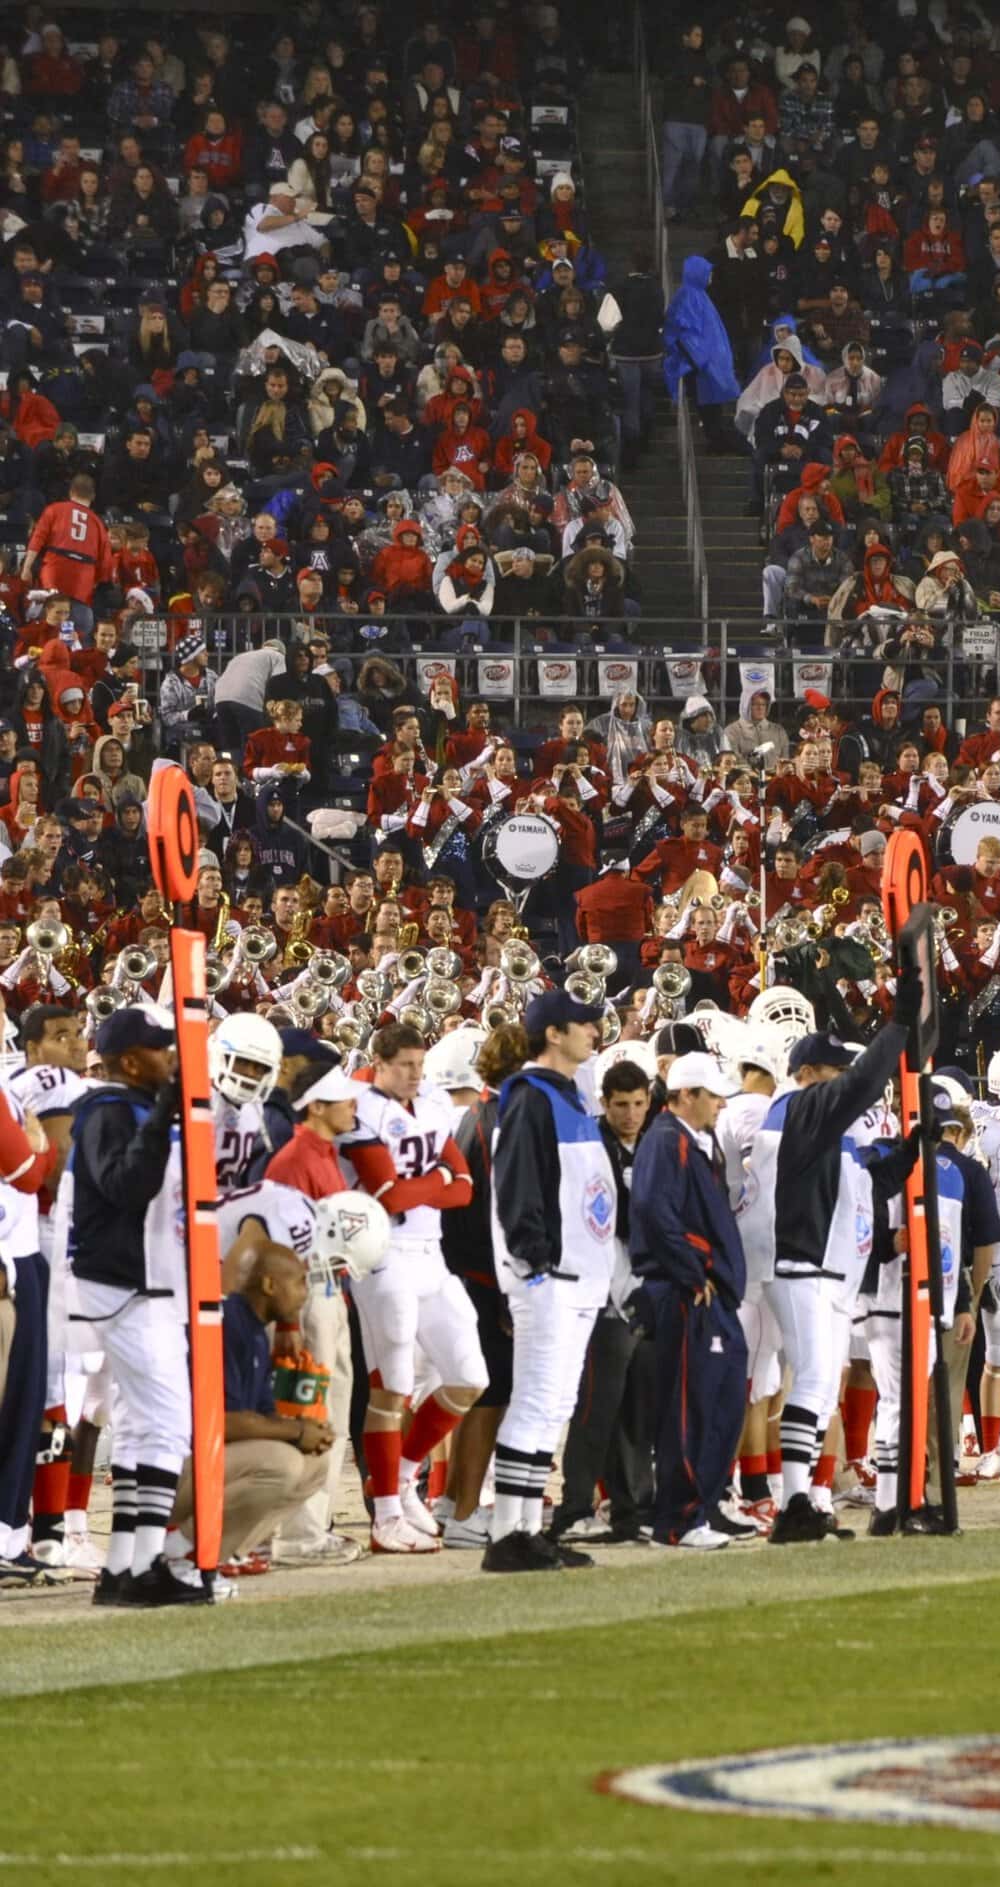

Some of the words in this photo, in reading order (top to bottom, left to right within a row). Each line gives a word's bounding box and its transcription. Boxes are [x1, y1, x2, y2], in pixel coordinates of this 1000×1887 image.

[71, 509, 88, 541] 5
[310, 550, 329, 570] A
[517, 824, 547, 834] YAMAHA
[296, 1379, 317, 1402] G
